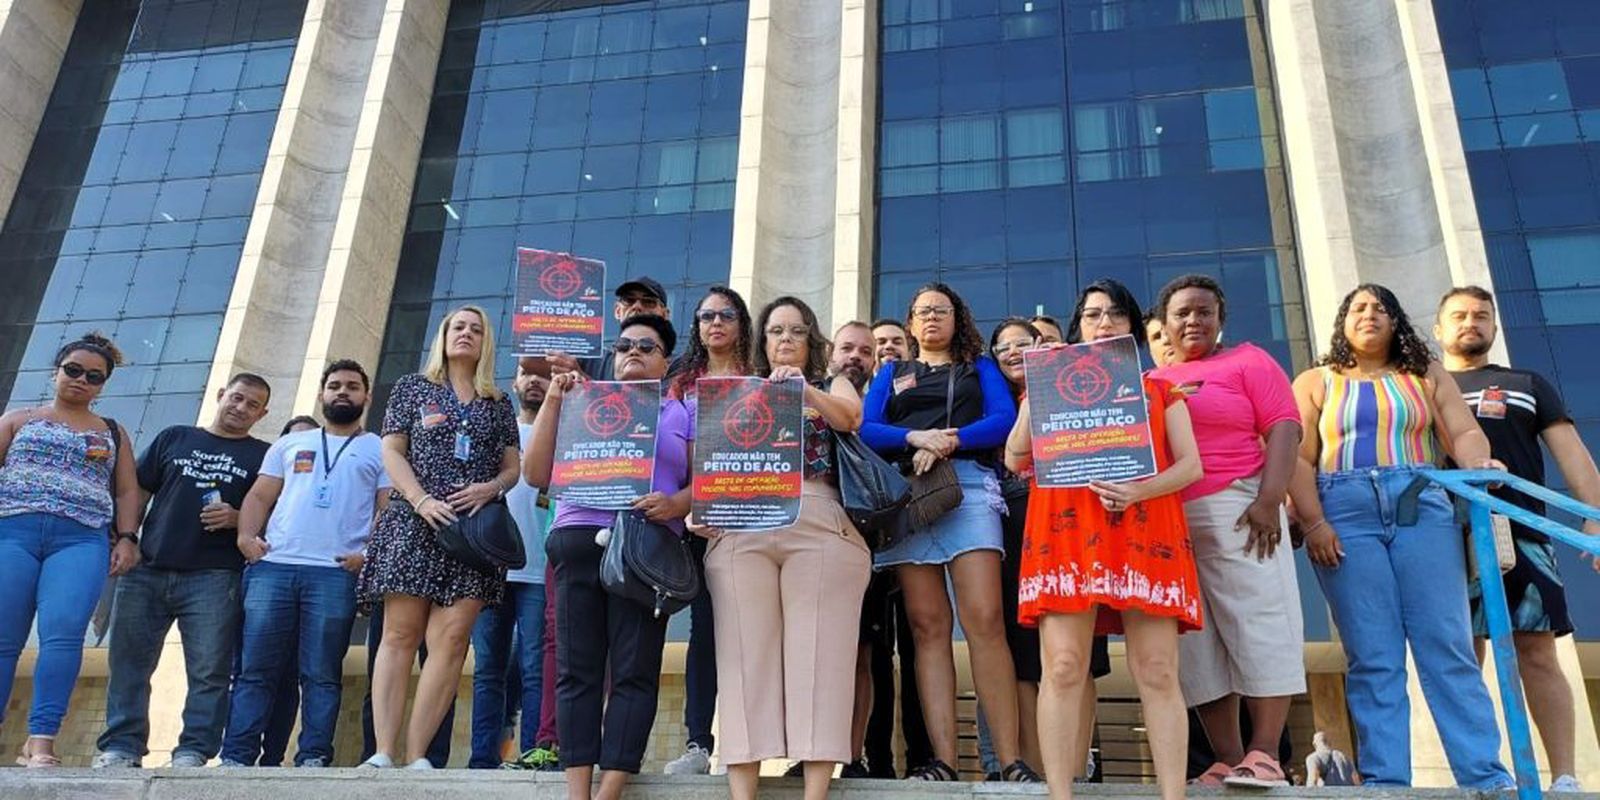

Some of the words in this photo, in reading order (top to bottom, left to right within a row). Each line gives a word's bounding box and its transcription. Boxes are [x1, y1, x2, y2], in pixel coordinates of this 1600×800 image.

[523, 305, 554, 314] PEITO
[556, 307, 571, 315] DE
[572, 308, 595, 318] AÇO
[1050, 410, 1089, 421] EDUCADOR
[1091, 408, 1107, 417] NÃO
[1108, 407, 1123, 416] TEM
[1041, 419, 1082, 433] PEITO
[1084, 417, 1102, 428] DE
[1105, 415, 1136, 427] AÇO
[191, 449, 235, 465] Sorria,
[564, 449, 598, 460] PEITO
[600, 449, 616, 458] DE
[618, 448, 645, 460] AÇO
[712, 452, 749, 461] EDUCADOR
[750, 451, 766, 461] NÃO
[767, 452, 781, 461] TEM
[173, 458, 202, 468] você
[203, 462, 230, 472] está
[231, 466, 248, 478] na
[182, 465, 233, 483] Reserva
[704, 461, 741, 472] PEITO
[743, 462, 761, 472] DE
[763, 461, 791, 474] AÇO
